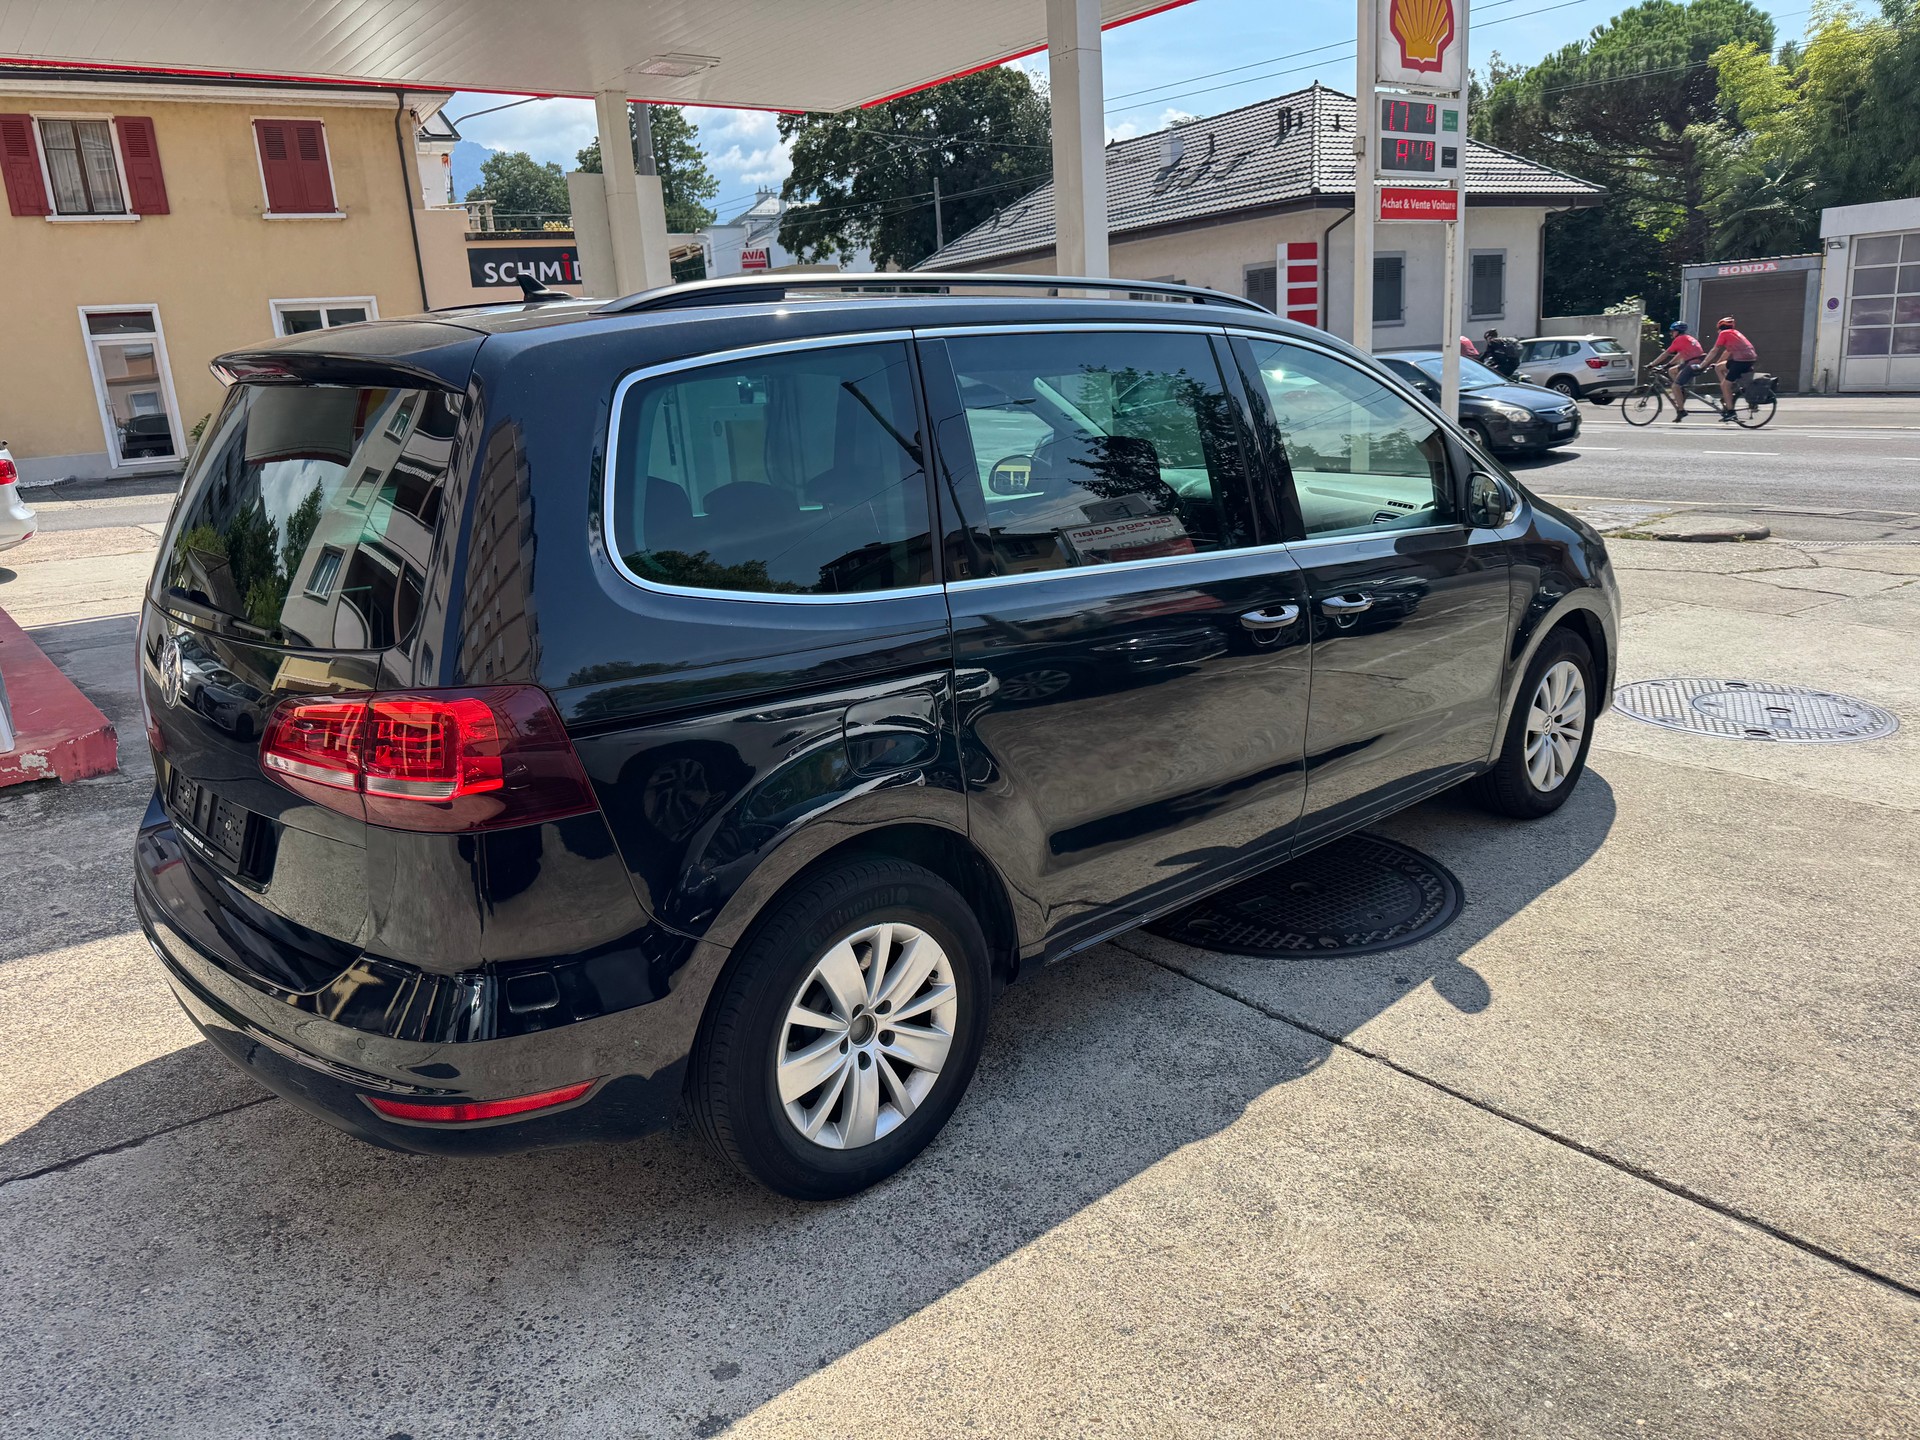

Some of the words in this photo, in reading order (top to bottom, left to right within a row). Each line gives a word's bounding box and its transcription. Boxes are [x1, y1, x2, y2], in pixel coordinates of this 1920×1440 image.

[1381, 197, 1402, 209] Achat
[1403, 198, 1410, 209] &
[1410, 198, 1430, 210] Vente
[1431, 199, 1456, 210] Voiture
[1717, 262, 1778, 275] HONDA
